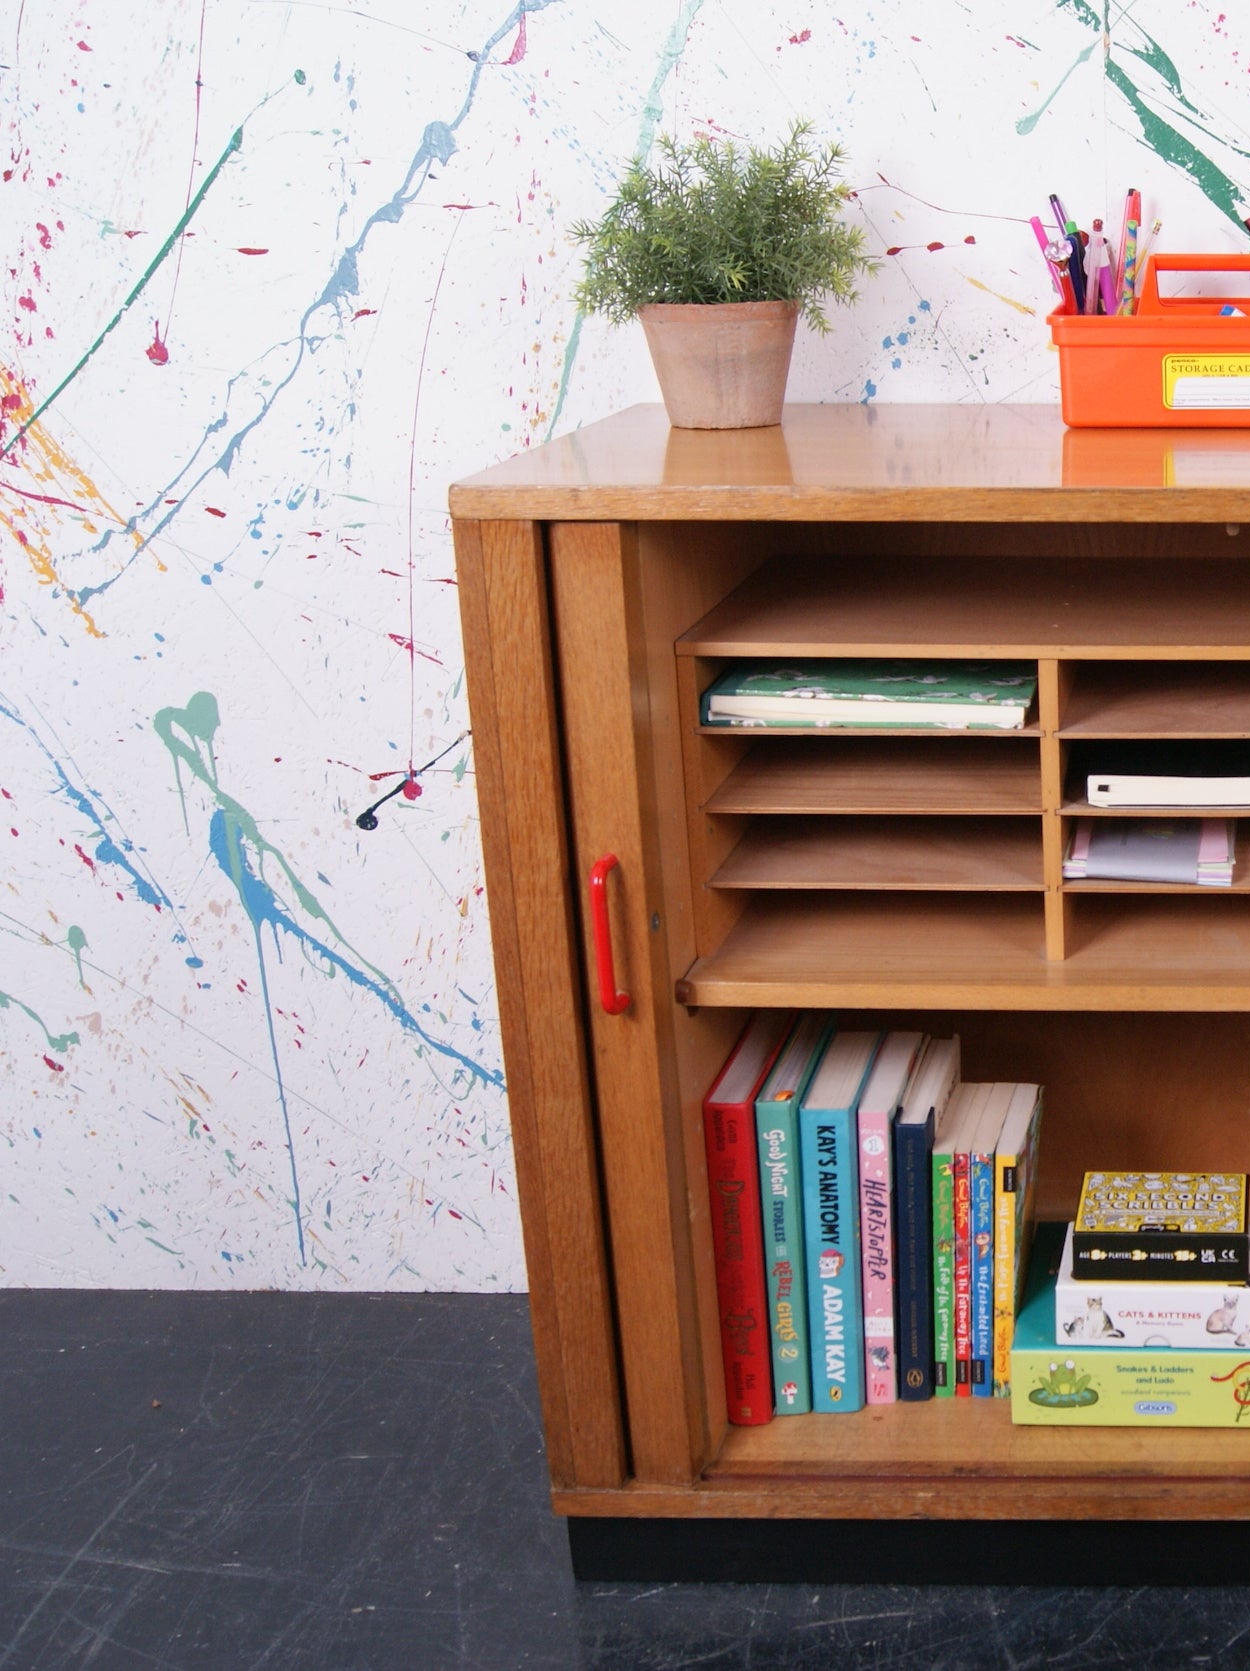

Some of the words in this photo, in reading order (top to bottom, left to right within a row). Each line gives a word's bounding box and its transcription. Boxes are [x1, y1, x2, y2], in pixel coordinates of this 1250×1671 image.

[1171, 364, 1225, 373] STORAGE
[817, 1125, 837, 1166] KAY'S
[957, 1178, 968, 1202] Enid
[976, 1178, 989, 1202] Enid
[1136, 1193, 1225, 1201] SECOND
[818, 1171, 840, 1245] ANATOMY
[958, 1203, 969, 1228] Blyton
[977, 1202, 990, 1228] Blyton
[1099, 1201, 1219, 1210] SCRIBBLES
[773, 1200, 787, 1243] STORIES
[863, 1179, 887, 1280] HEARTSTOPPER
[1150, 1252, 1174, 1260] MINUTES
[1200, 1249, 1215, 1257] UK
[772, 1261, 793, 1300] REBEL
[822, 1284, 845, 1341] ADAM
[957, 1293, 969, 1334] Faraway
[978, 1282, 990, 1330] Enchanted
[1118, 1311, 1144, 1319] CATS
[1158, 1311, 1202, 1320] KITTENS
[775, 1302, 799, 1341] GIRLS
[937, 1308, 949, 1341] Faraway
[780, 1347, 798, 1359] 2
[958, 1337, 969, 1355] Tree
[978, 1331, 990, 1355] Wood
[825, 1344, 846, 1384] KAY
[1116, 1365, 1148, 1374] Snakes
[1151, 1365, 1157, 1374] &
[1159, 1365, 1194, 1374] Ladders
[1136, 1377, 1153, 1385] and
[1154, 1377, 1174, 1385] Ludo
[1138, 1404, 1172, 1413] Gibsons
